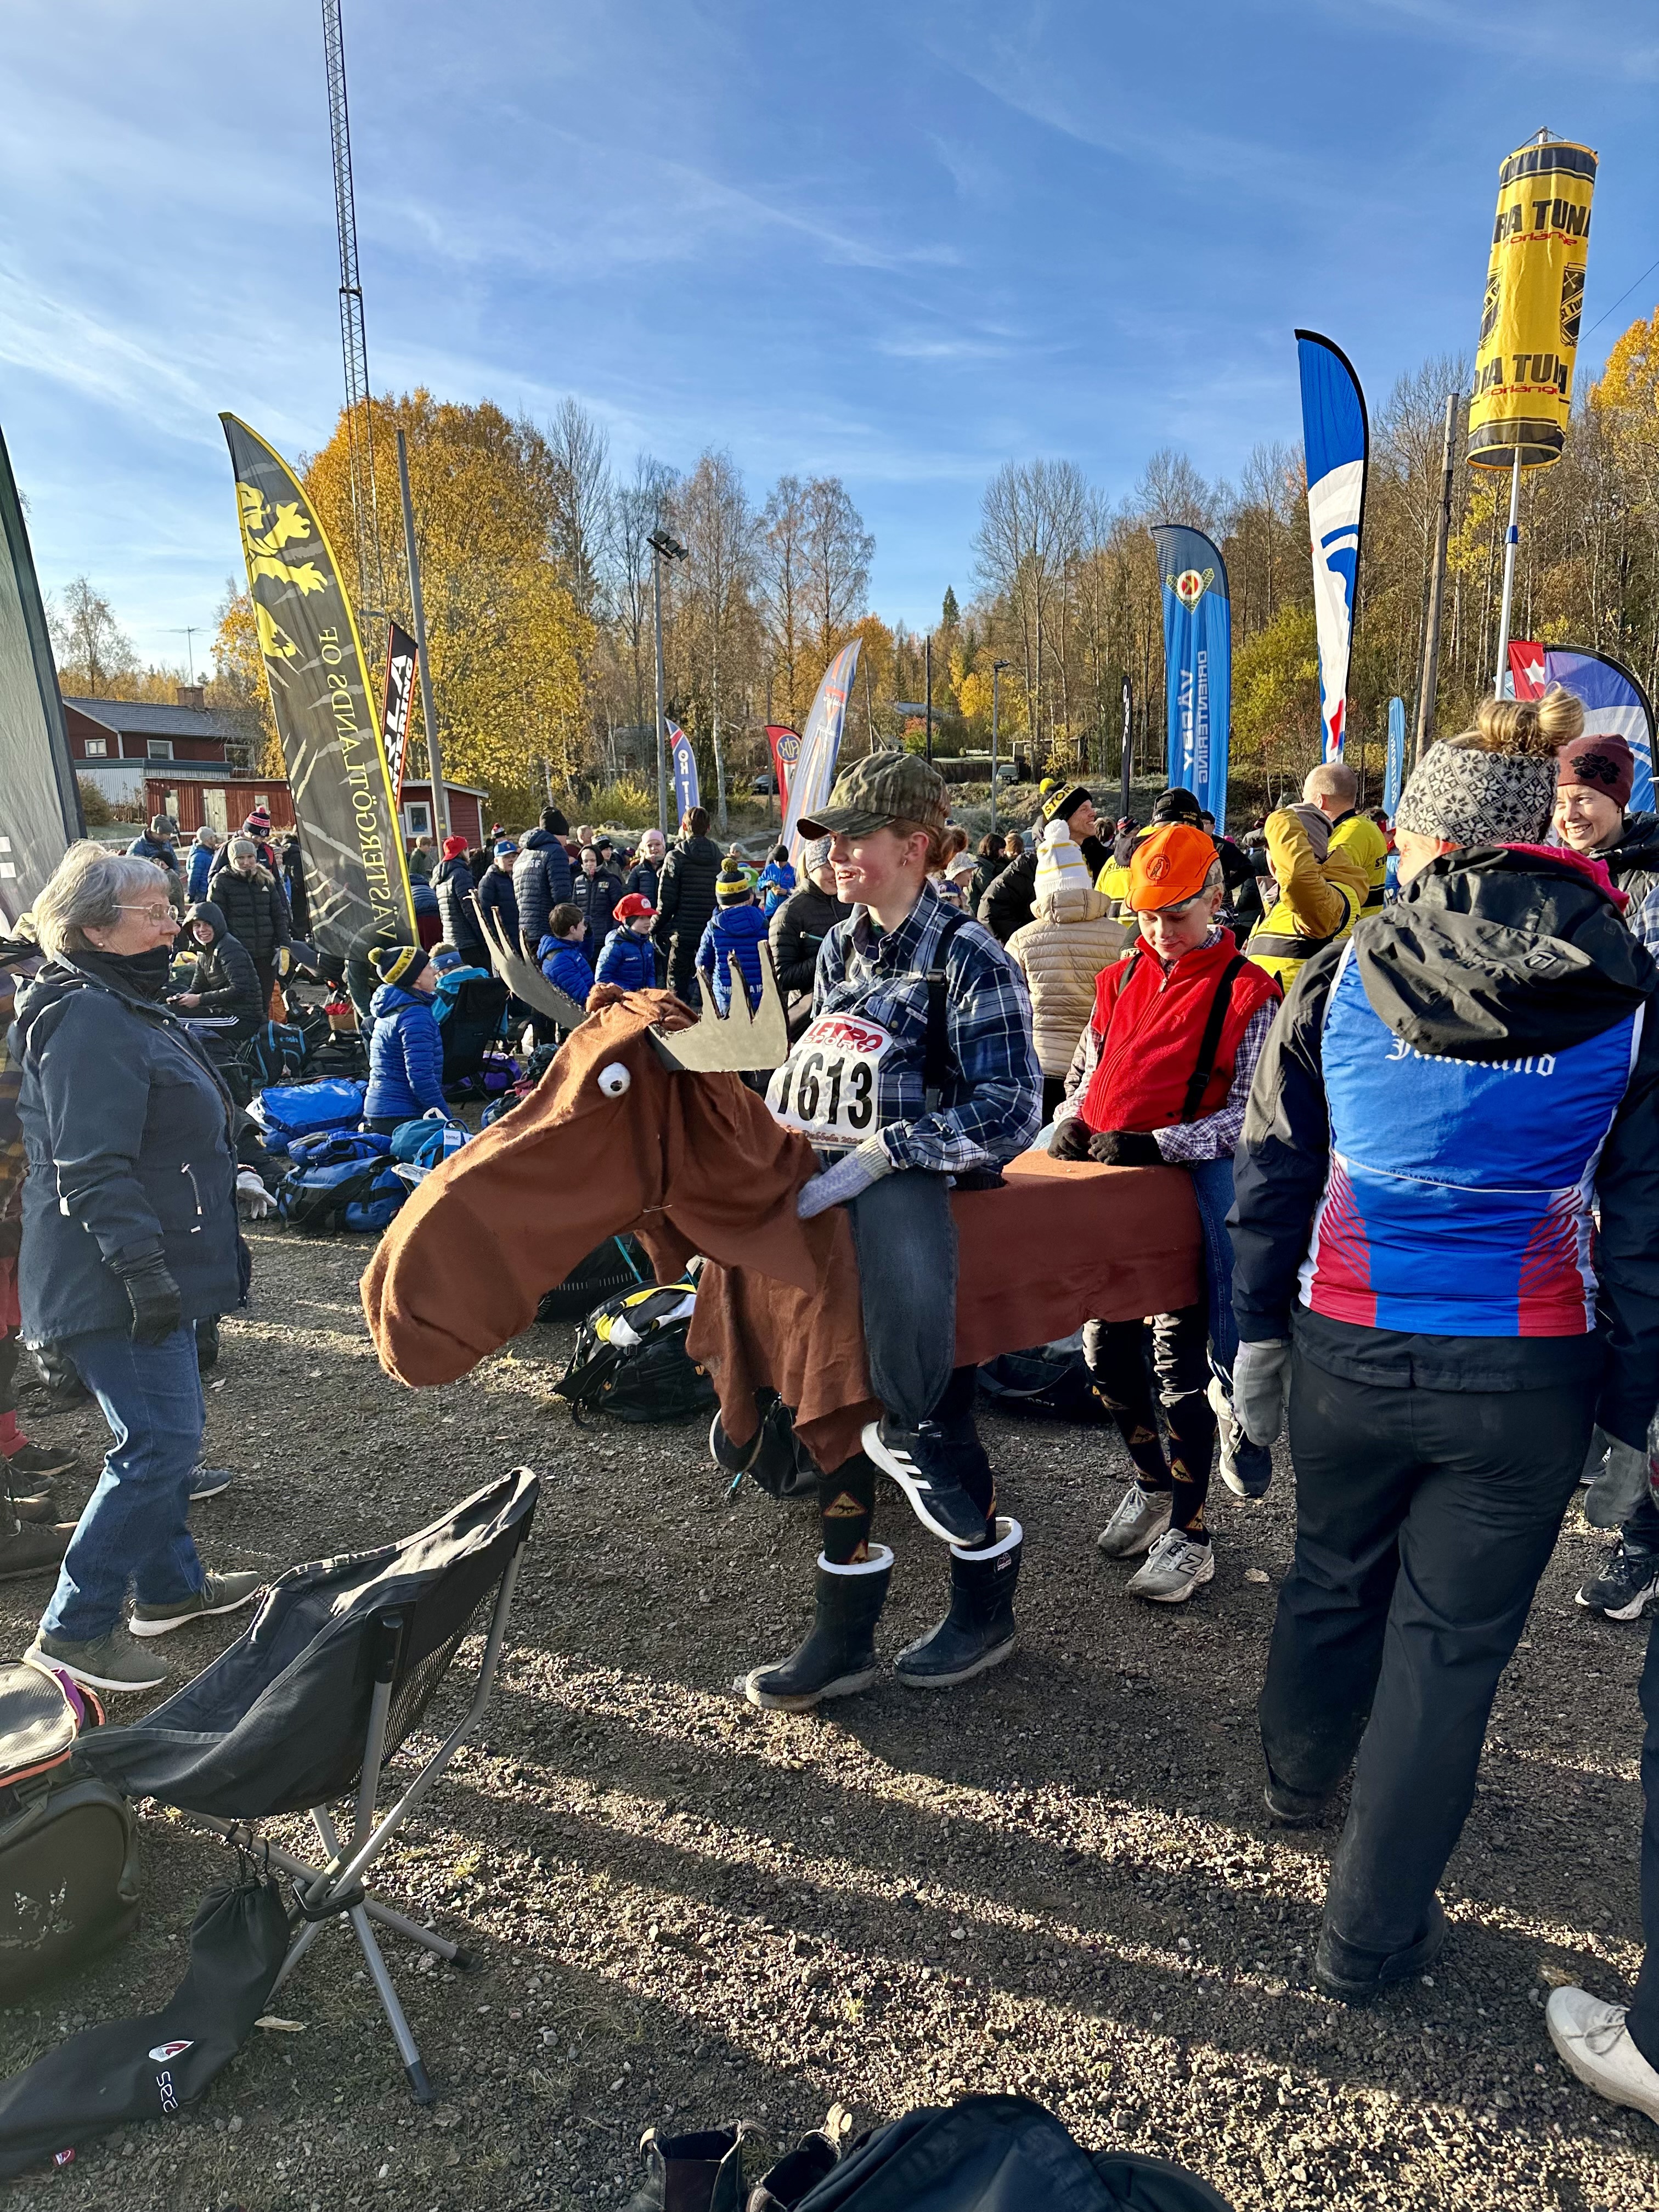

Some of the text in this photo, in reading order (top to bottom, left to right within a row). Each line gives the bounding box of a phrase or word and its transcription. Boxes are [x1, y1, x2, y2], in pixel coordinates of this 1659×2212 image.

[385, 654, 407, 782] RLA
[392, 657, 413, 800] NTERING
[777, 1049, 873, 1130] 1613
[802, 1035, 876, 1052] SPORT
